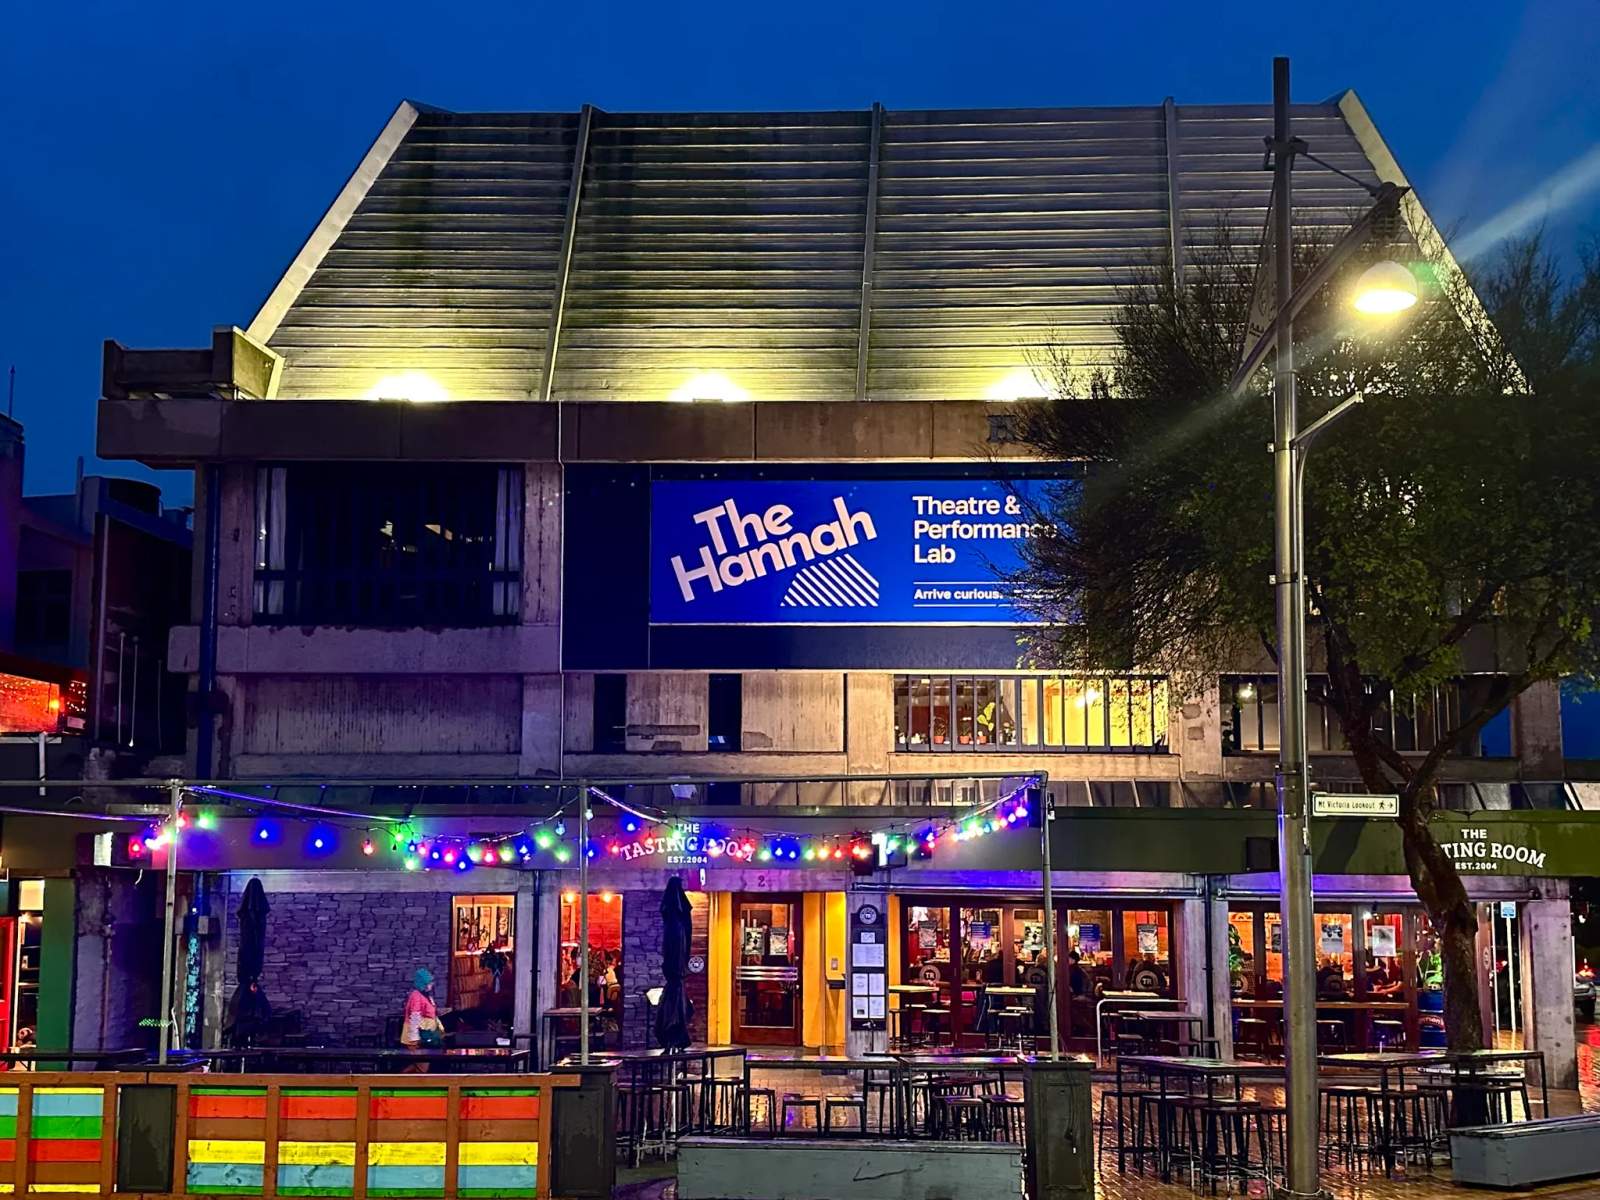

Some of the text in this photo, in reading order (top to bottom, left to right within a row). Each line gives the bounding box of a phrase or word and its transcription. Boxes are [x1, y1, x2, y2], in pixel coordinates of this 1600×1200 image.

[912, 495, 1022, 515] Theatre &
[693, 498, 794, 556] The
[671, 496, 878, 603] Hannah
[914, 544, 956, 563] Lab
[914, 588, 951, 600] Arrive
[954, 588, 1003, 600] curious.
[1327, 800, 1350, 809] Victoria
[1352, 801, 1375, 809] Lookout
[675, 823, 700, 834] THE
[1461, 829, 1487, 839] THE
[667, 856, 708, 864] EST.2004
[1440, 842, 1547, 868] TING ROOM
[1455, 862, 1497, 870] EST.2004
[758, 875, 766, 888] 2
